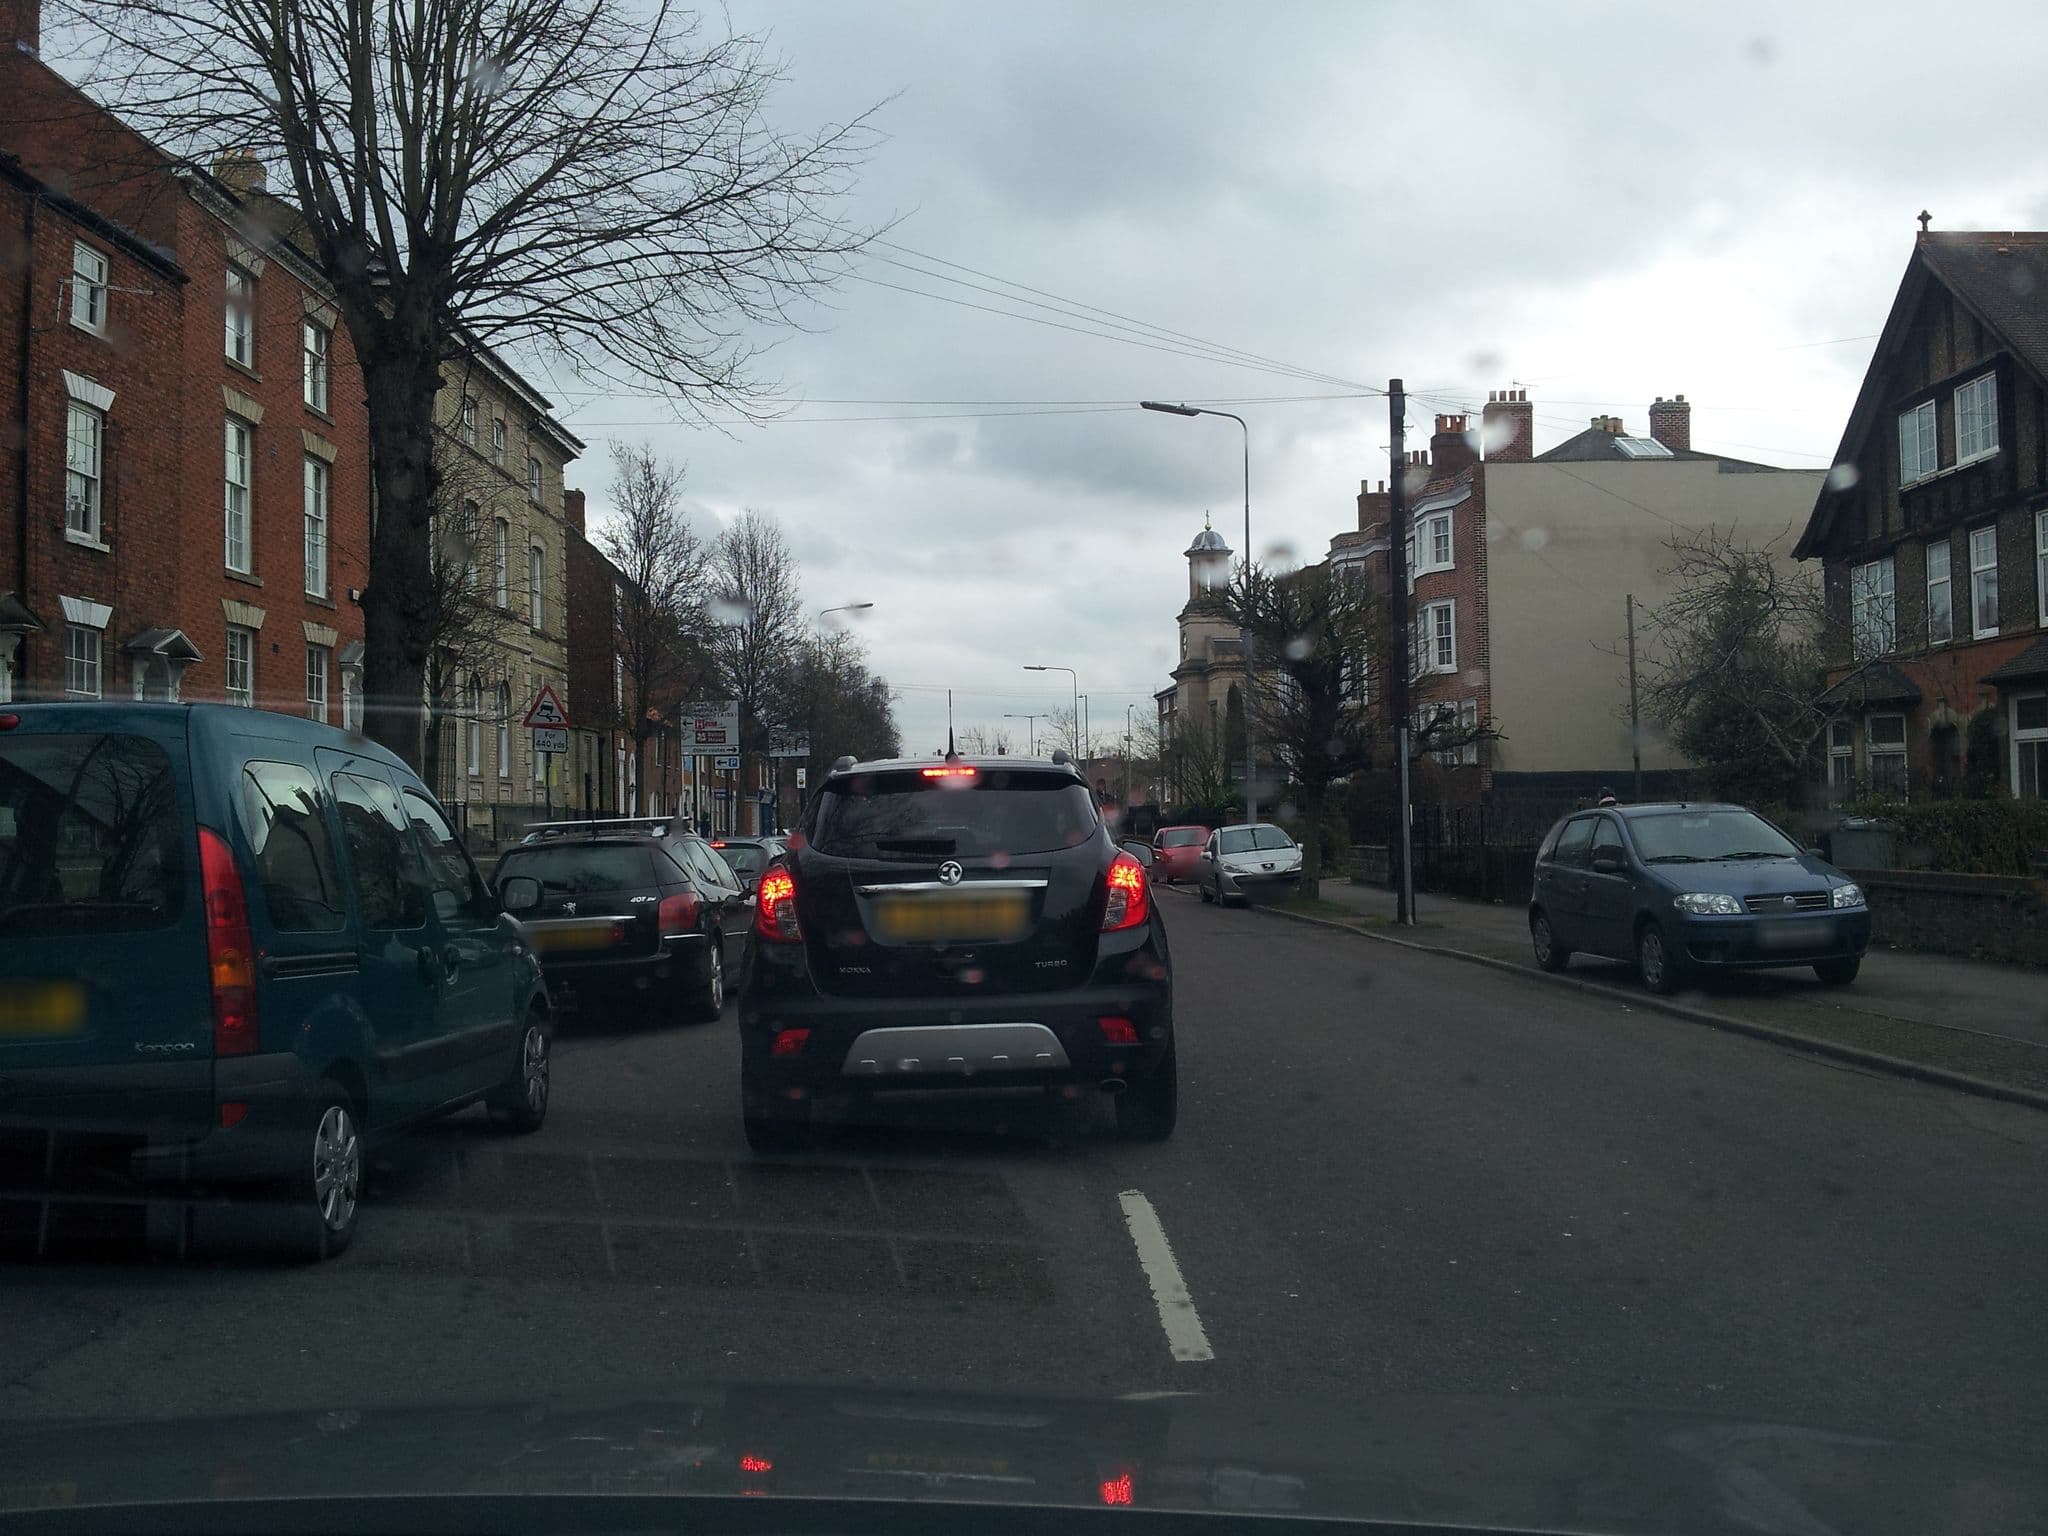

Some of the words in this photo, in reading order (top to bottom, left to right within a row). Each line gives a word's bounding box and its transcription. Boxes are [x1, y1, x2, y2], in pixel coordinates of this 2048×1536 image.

[544, 731, 556, 739] For
[553, 741, 565, 749] yds
[1034, 960, 1068, 968] TURBO
[134, 1041, 195, 1056] Kangoo
